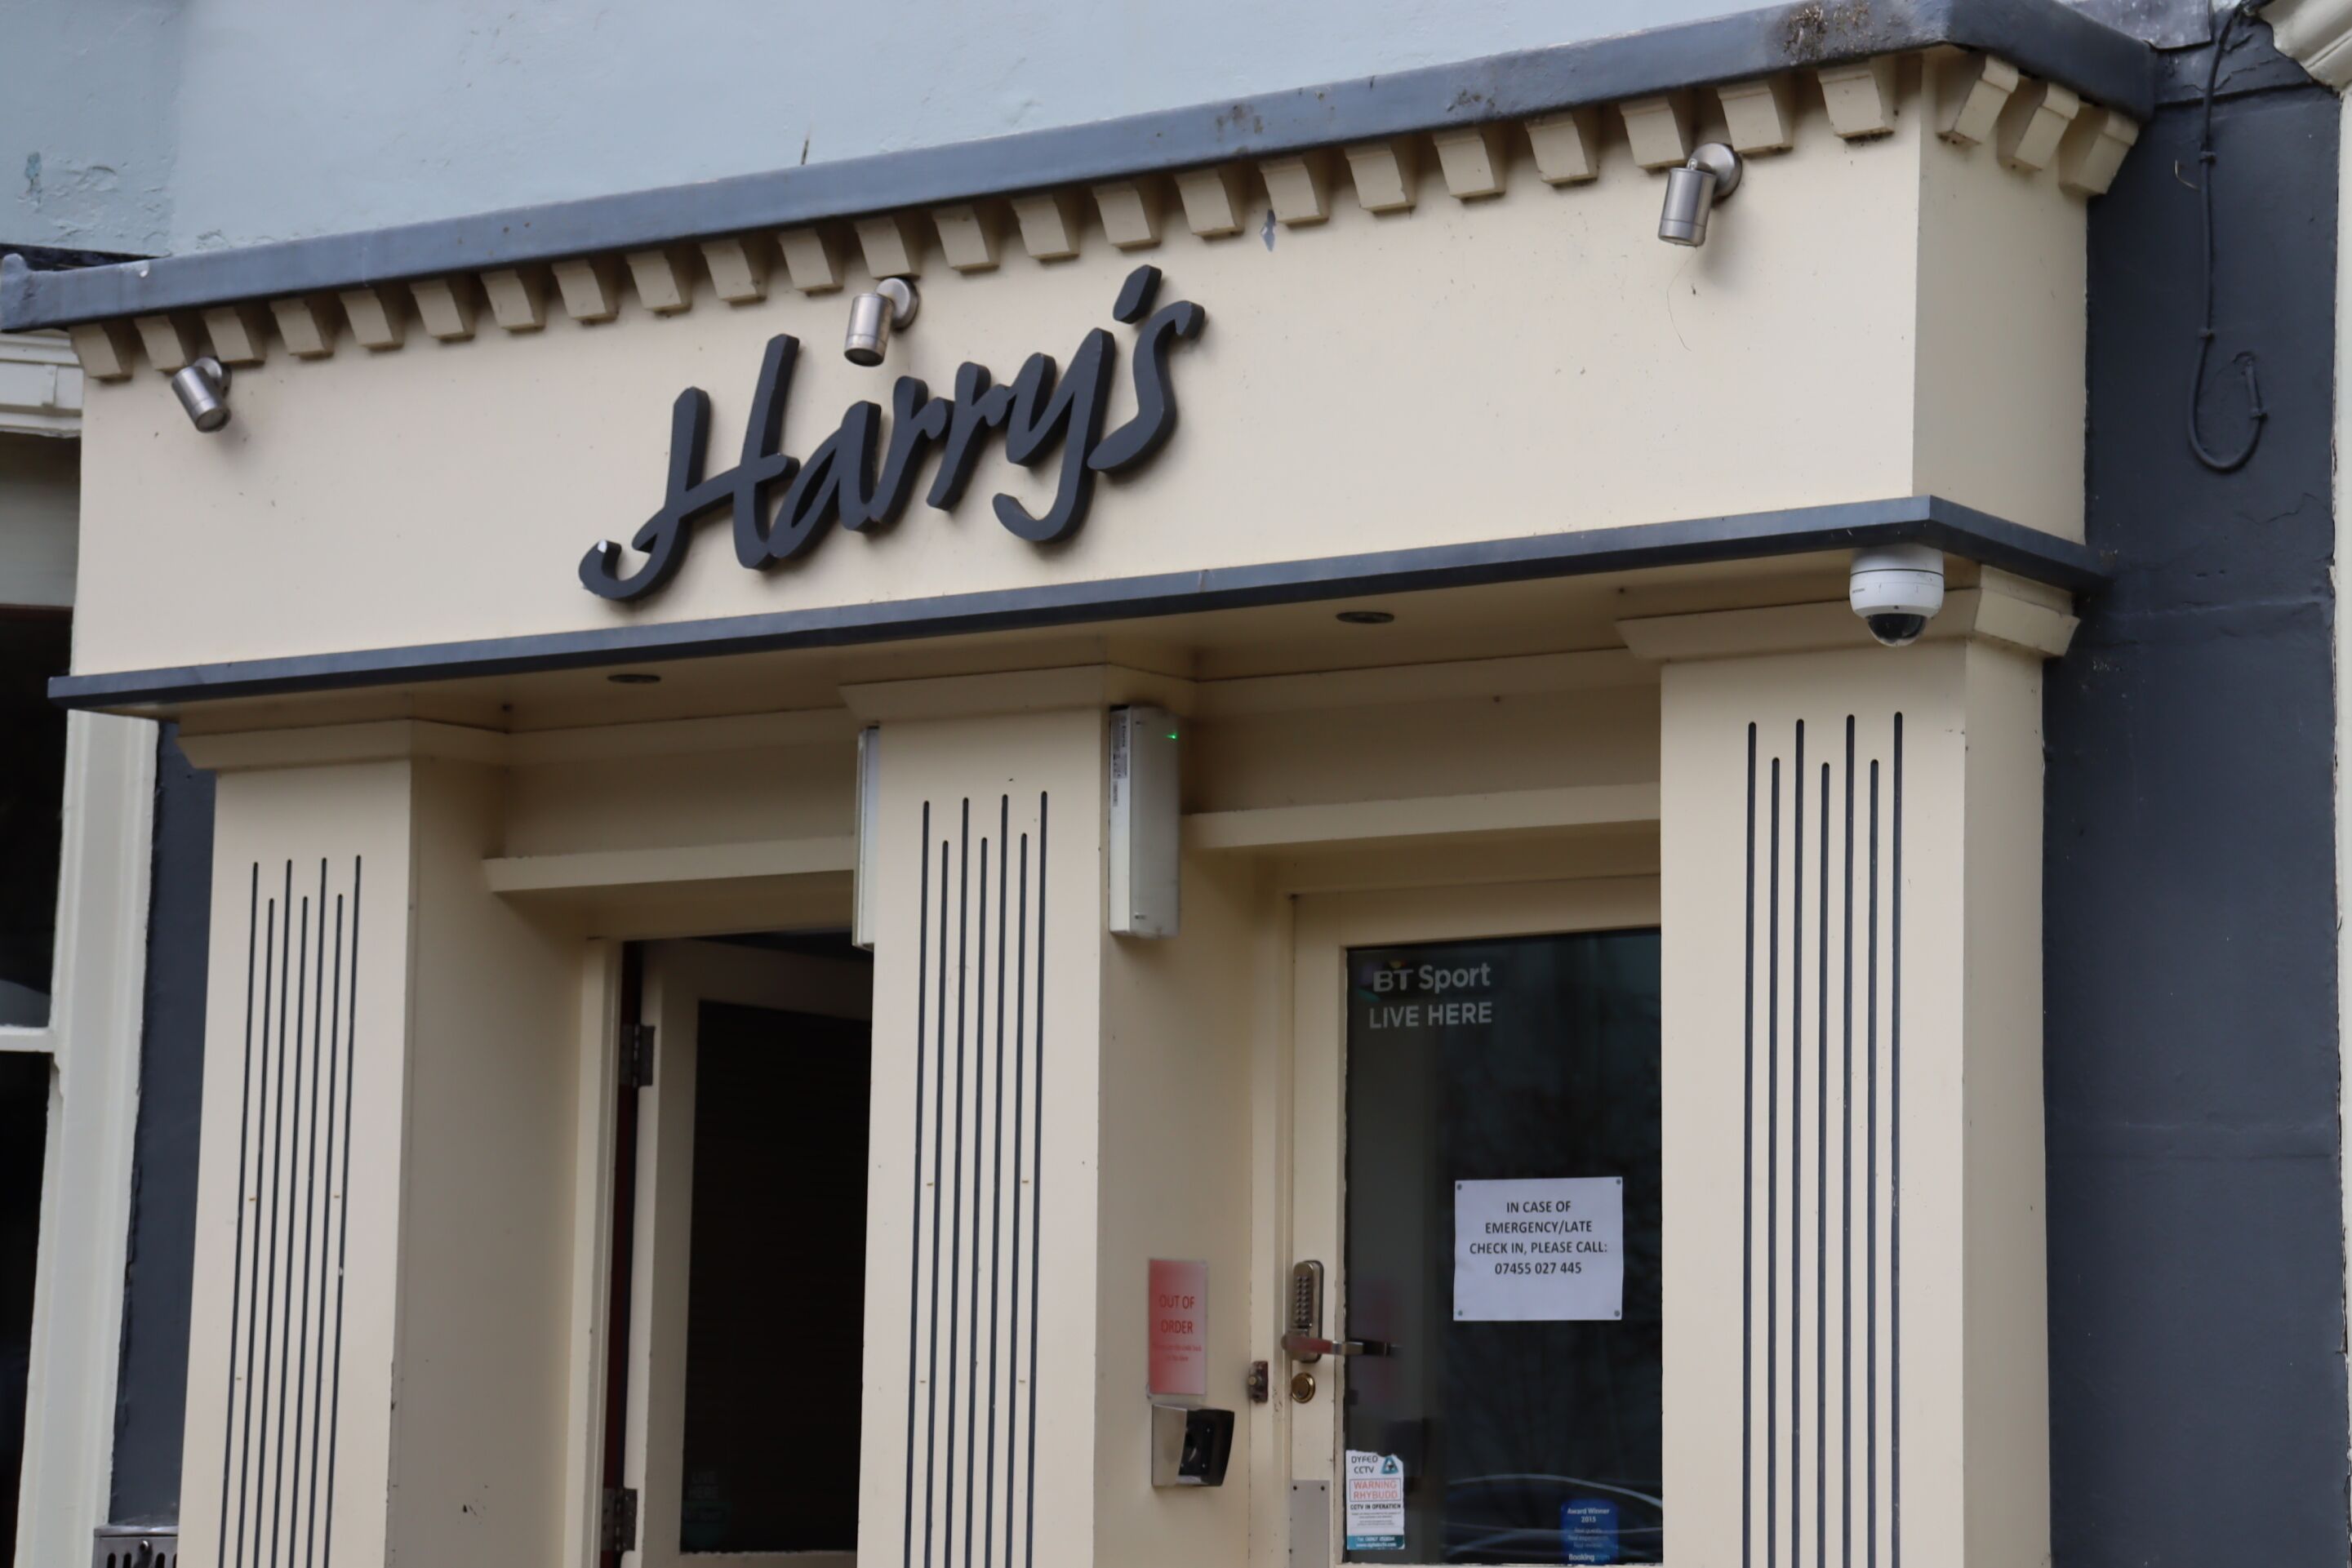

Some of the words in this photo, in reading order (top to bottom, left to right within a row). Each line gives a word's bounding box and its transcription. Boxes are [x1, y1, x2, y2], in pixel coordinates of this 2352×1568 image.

[578, 264, 1206, 602] Harry's
[1373, 969, 1413, 992] BT
[1418, 962, 1491, 994] Sport
[1369, 1005, 1419, 1028] LIVE
[1428, 1002, 1492, 1026] HERE
[1506, 1202, 1518, 1213] IN
[1523, 1201, 1552, 1213] CASE
[1555, 1200, 1572, 1212] OF
[1485, 1219, 1593, 1235] EMERGENCY/LATE
[1469, 1242, 1508, 1255] CHECK
[1511, 1242, 1527, 1256] IN,
[1531, 1241, 1572, 1254] PLEASE
[1576, 1241, 1607, 1253] CALL:
[1495, 1263, 1531, 1275] 07455
[1535, 1262, 1556, 1274] 027
[1560, 1262, 1582, 1274] 445
[1158, 1294, 1180, 1308] OUT
[1182, 1295, 1194, 1309] OF
[1160, 1319, 1194, 1334] ORDER
[1351, 1455, 1378, 1464] DYFED
[1354, 1466, 1374, 1474] CCTV
[1354, 1481, 1396, 1490] WARNING
[1354, 1490, 1398, 1499] RHYBUDD
